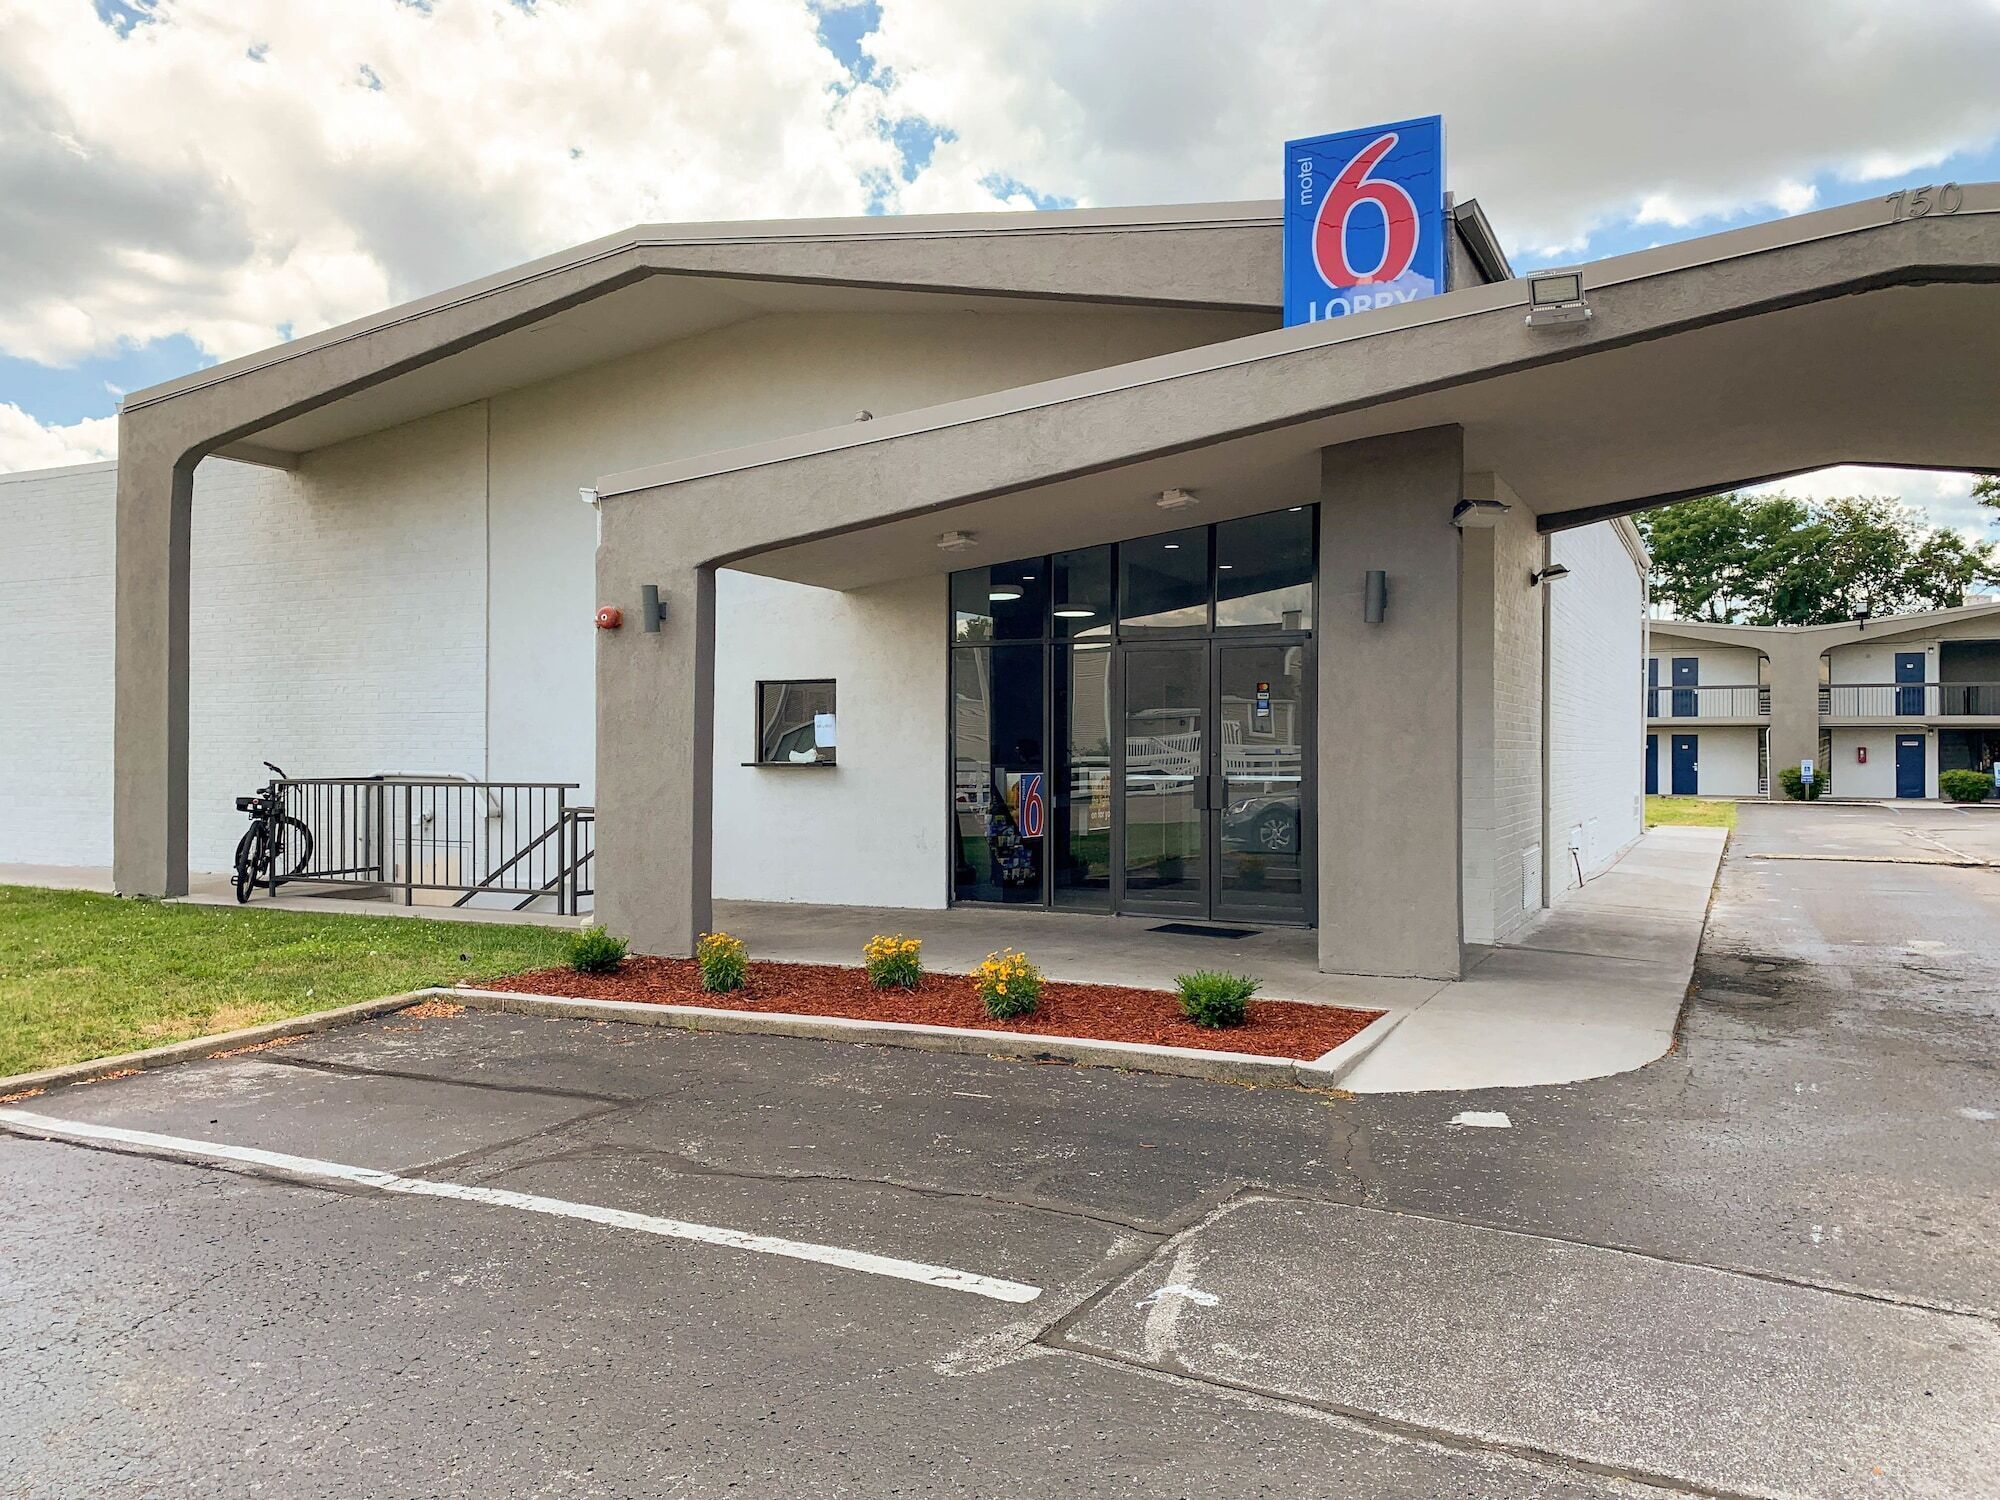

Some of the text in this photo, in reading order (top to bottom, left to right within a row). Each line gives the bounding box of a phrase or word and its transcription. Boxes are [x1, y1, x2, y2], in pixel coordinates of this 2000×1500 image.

[1298, 132, 1420, 289] motel 6
[1885, 181, 1963, 223] 750
[1024, 775, 1044, 836] 6
